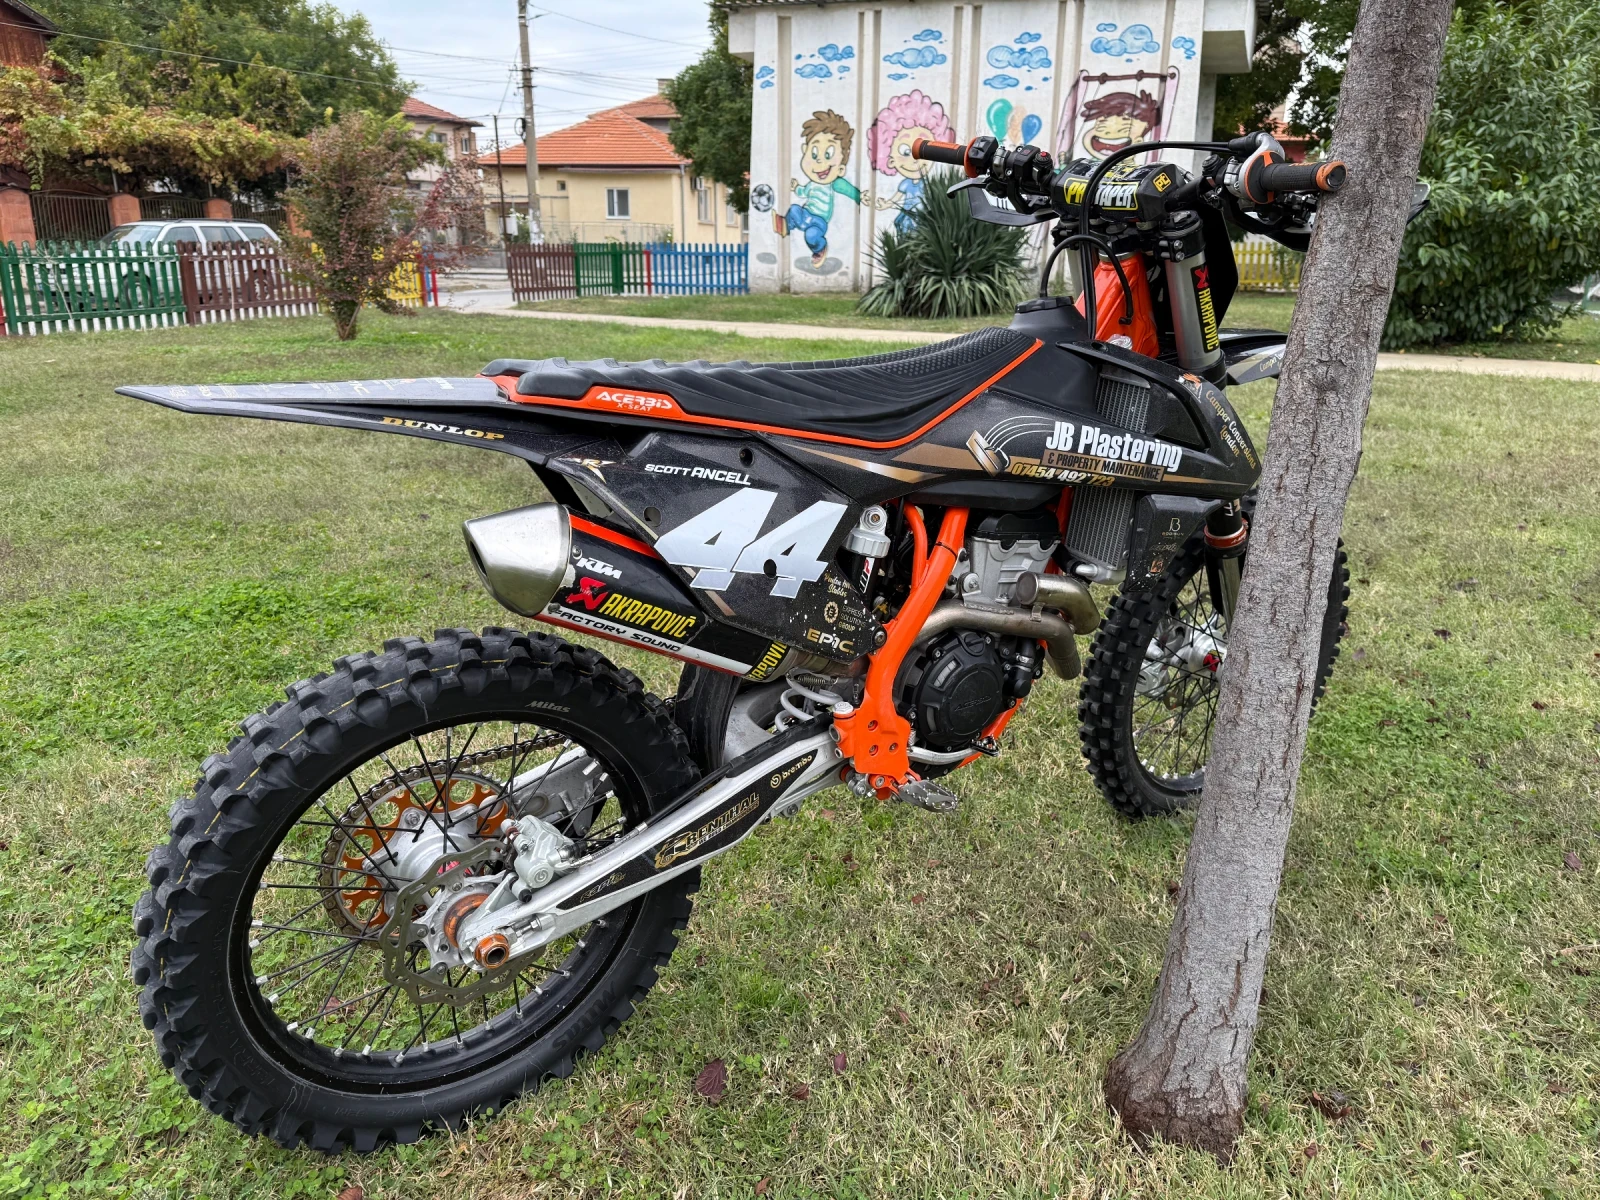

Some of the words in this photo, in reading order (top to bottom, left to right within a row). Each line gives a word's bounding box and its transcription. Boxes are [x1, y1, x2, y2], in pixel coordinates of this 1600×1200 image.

[1067, 181, 1088, 204] PR
[1094, 184, 1135, 208] TAPER
[596, 391, 673, 410] ACERBIS
[617, 403, 652, 412] X-SEAT
[381, 416, 505, 440] DUNLOP
[1205, 390, 1231, 423] Camper
[1228, 420, 1257, 470] Conversions
[1045, 421, 1075, 451] JB
[1077, 425, 1183, 473] Plastering
[1219, 424, 1241, 458] London
[644, 463, 691, 476] SCOTT
[691, 466, 751, 486] ANCELL
[1011, 461, 1057, 480] 07454
[1056, 453, 1101, 472] PROPERTY
[1101, 460, 1162, 481] MAINTENANCE
[653, 486, 849, 599] 44
[576, 557, 623, 580] KTM
[630, 632, 682, 652] SOUND
[524, 700, 571, 713] Mitas
[781, 754, 813, 781] brembo
[686, 791, 760, 850] RENTHAL
